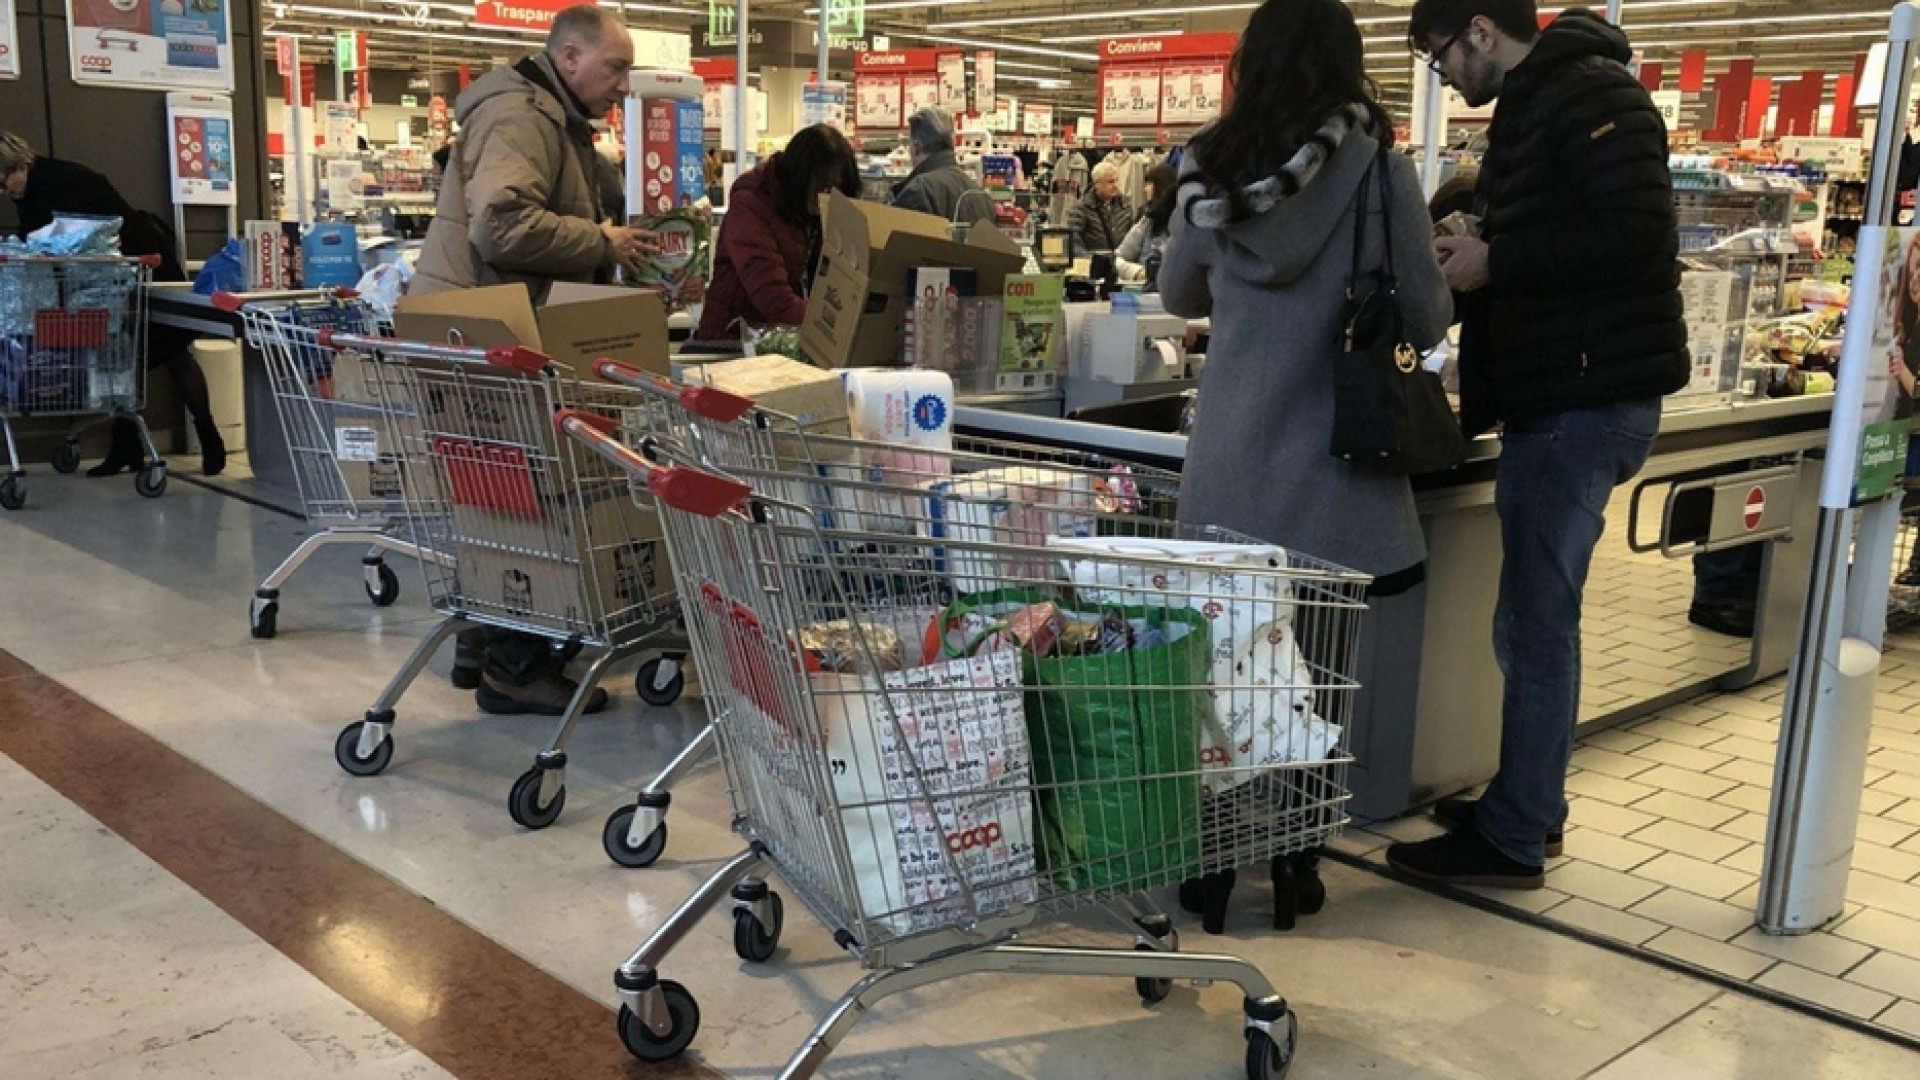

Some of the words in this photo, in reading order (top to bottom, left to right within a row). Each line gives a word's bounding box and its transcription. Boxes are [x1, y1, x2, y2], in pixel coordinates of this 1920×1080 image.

[1107, 38, 1163, 55] Conviene
[80, 55, 112, 69] coop
[861, 53, 906, 66] Conviene
[947, 821, 1001, 853] coop
